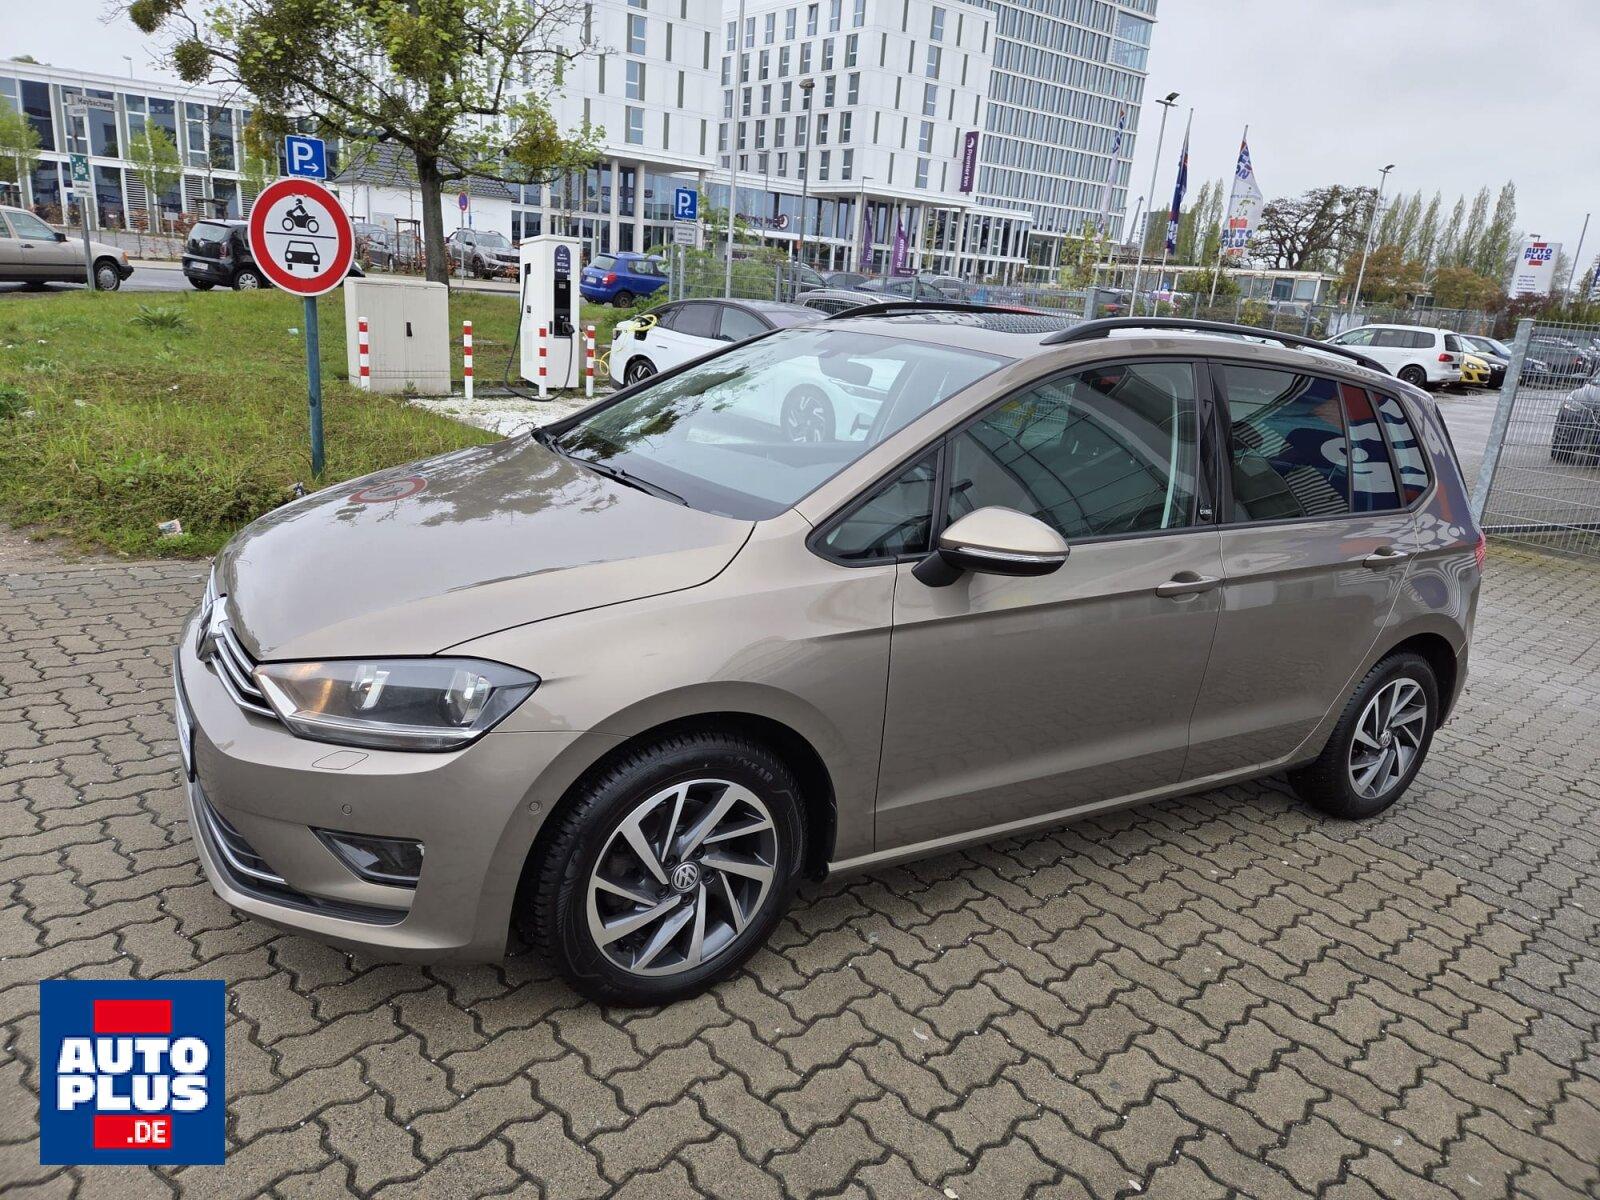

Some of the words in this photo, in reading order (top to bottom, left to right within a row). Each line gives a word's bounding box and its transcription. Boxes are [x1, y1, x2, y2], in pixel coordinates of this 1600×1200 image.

[292, 141, 314, 171] P
[964, 149, 973, 175] Premier
[678, 192, 691, 215] P
[1525, 247, 1553, 255] AUTO
